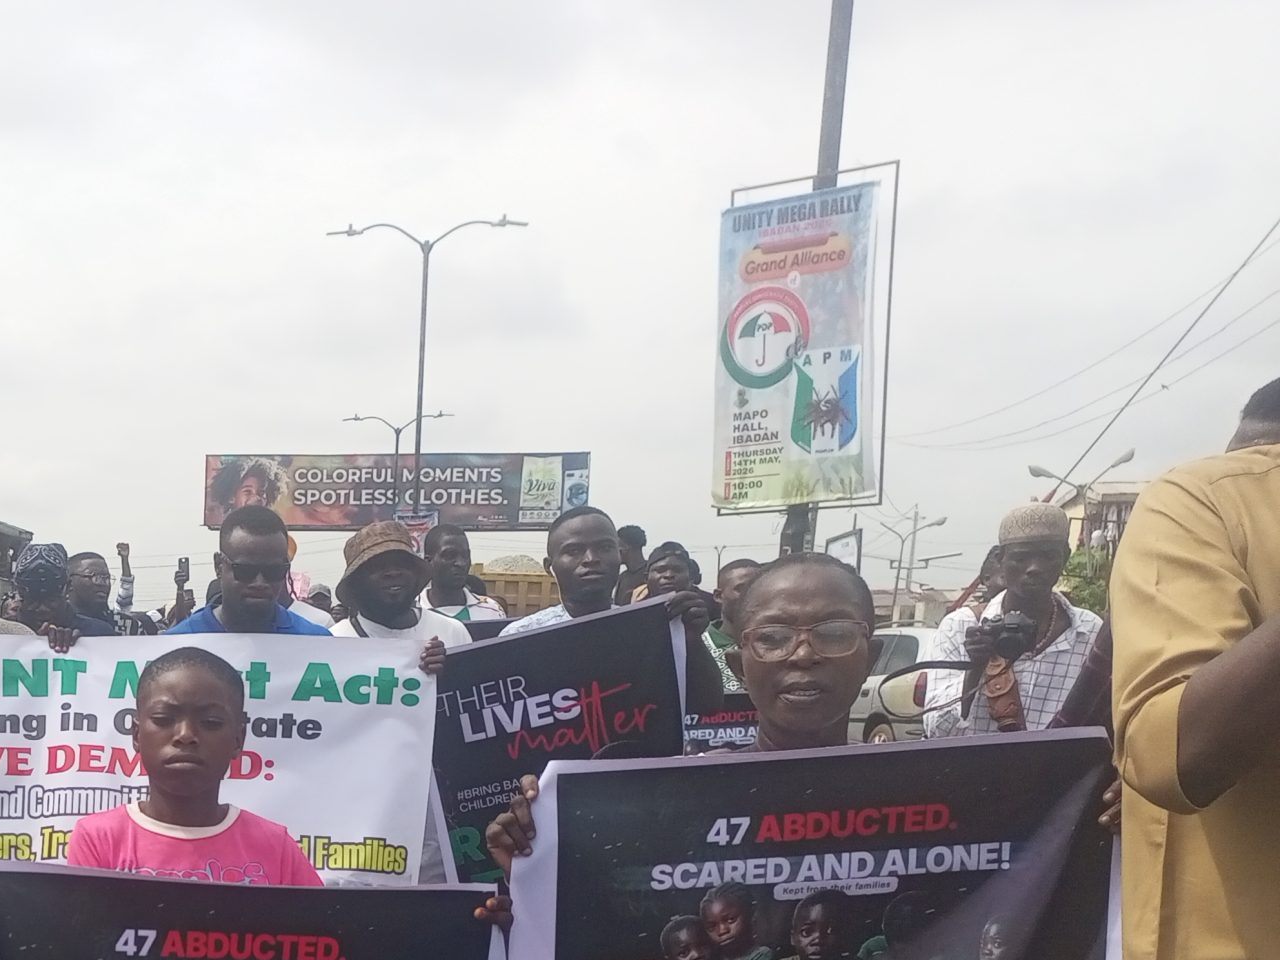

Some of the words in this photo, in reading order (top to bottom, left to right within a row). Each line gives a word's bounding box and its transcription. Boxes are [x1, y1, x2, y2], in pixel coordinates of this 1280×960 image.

[732, 209, 774, 233] UNITY
[777, 201, 816, 225] MEGA
[820, 193, 862, 217] RALLY
[745, 255, 787, 275] Grand
[790, 249, 846, 267] Alliance
[757, 322, 773, 332] PDP
[733, 409, 768, 422] MAPO
[733, 422, 768, 434] HALL,
[733, 431, 779, 445] IBADAN
[733, 447, 784, 459] THURSDAY
[733, 458, 756, 468] 14TH
[759, 456, 781, 465] MAY,
[294, 468, 395, 483] COLORFUL
[402, 468, 503, 483] MOMENTS
[732, 467, 754, 476] 2026
[525, 478, 556, 497] Viva
[732, 480, 763, 490] 10:00
[294, 488, 398, 505] SPOTLESS
[405, 488, 508, 505] CLOTHES.
[731, 491, 748, 500] AM
[292, 662, 421, 707] Act:
[436, 676, 528, 717] THEIR
[60, 703, 98, 733] in
[460, 688, 581, 743] LIVES
[507, 681, 657, 760] matter
[684, 714, 700, 725] 47
[702, 710, 759, 724] ABDUCT
[684, 729, 715, 741] ARED
[717, 727, 744, 739] AND
[45, 744, 274, 781] DEMD:
[457, 783, 501, 801] #BRING
[503, 778, 521, 791] BA
[28, 785, 149, 818] Communiti
[459, 790, 520, 812] CHILDREN
[706, 816, 751, 846] 47
[755, 803, 958, 844] ABDUCTED.
[314, 836, 408, 875] Families
[650, 856, 791, 891] SCARED
[795, 851, 875, 883] AND
[877, 841, 1012, 877] ALONE!
[783, 887, 804, 896] Kept
[855, 881, 891, 890] families
[115, 929, 157, 957] 47
